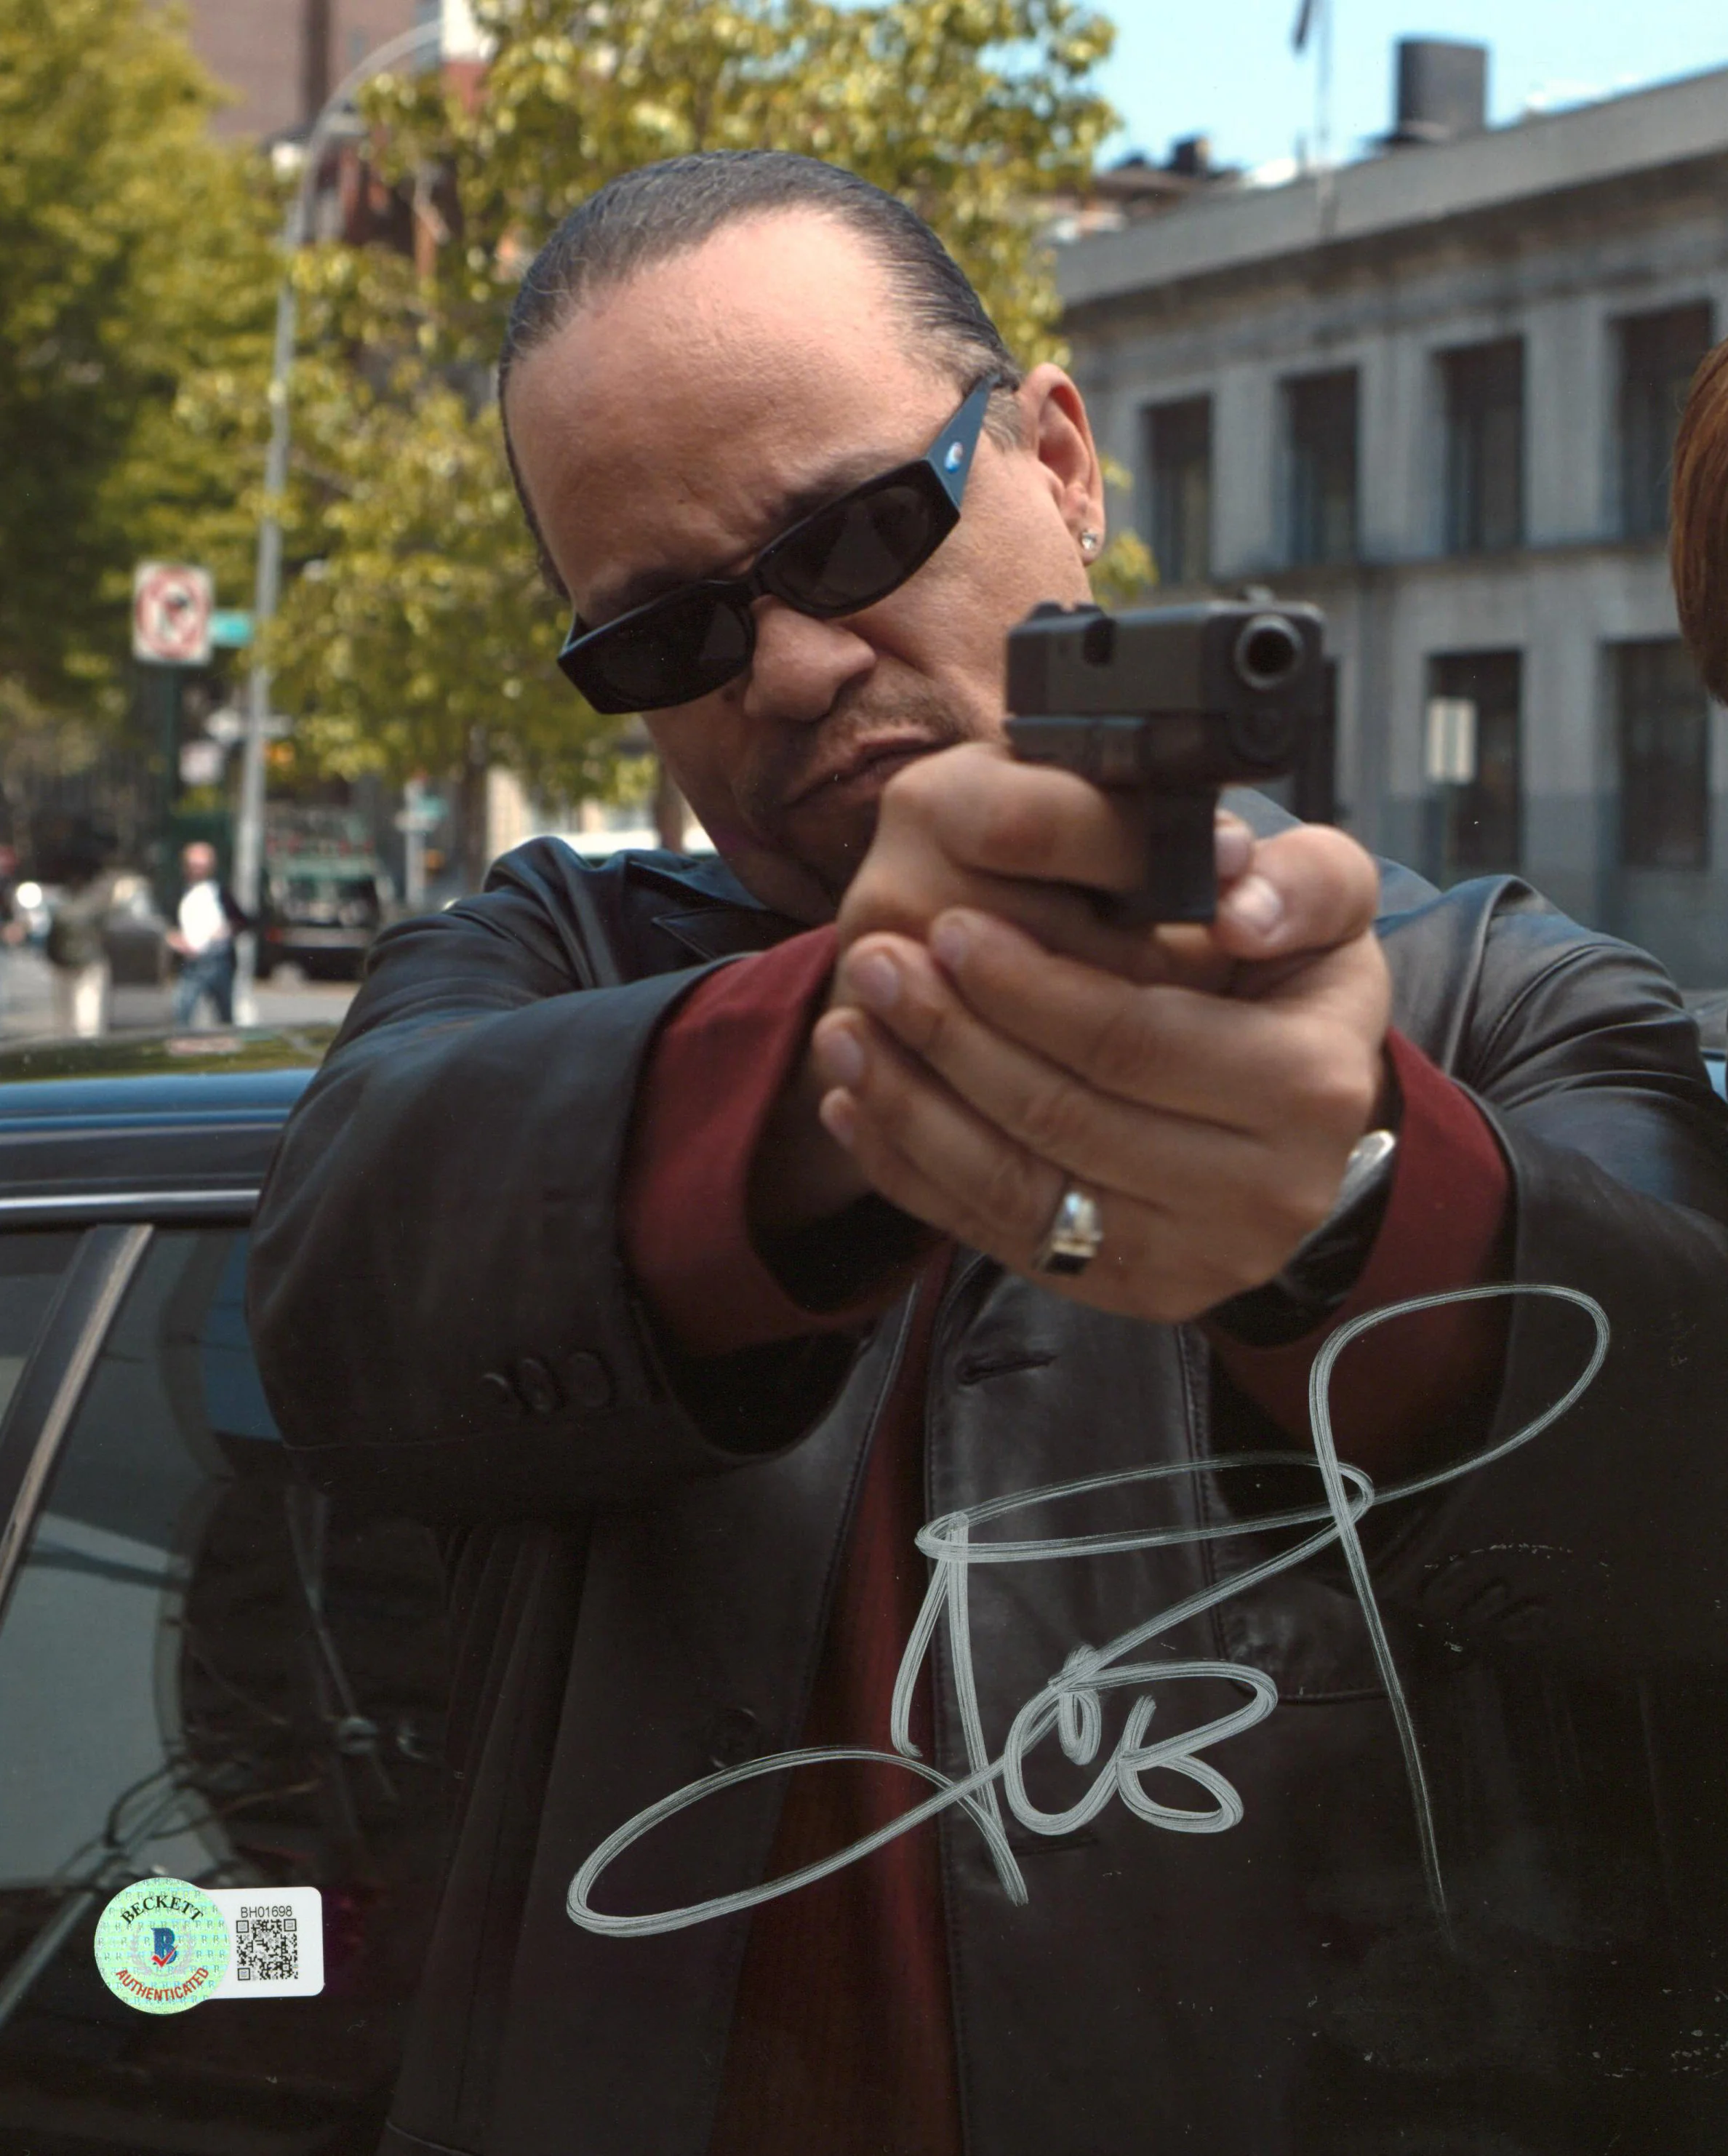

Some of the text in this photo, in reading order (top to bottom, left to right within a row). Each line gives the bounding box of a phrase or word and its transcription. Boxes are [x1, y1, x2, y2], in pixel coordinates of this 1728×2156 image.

[121, 1895, 204, 1925] BECKETT
[241, 1905, 292, 1918] BH01698
[116, 1967, 209, 2002] AUTHENTICATED
